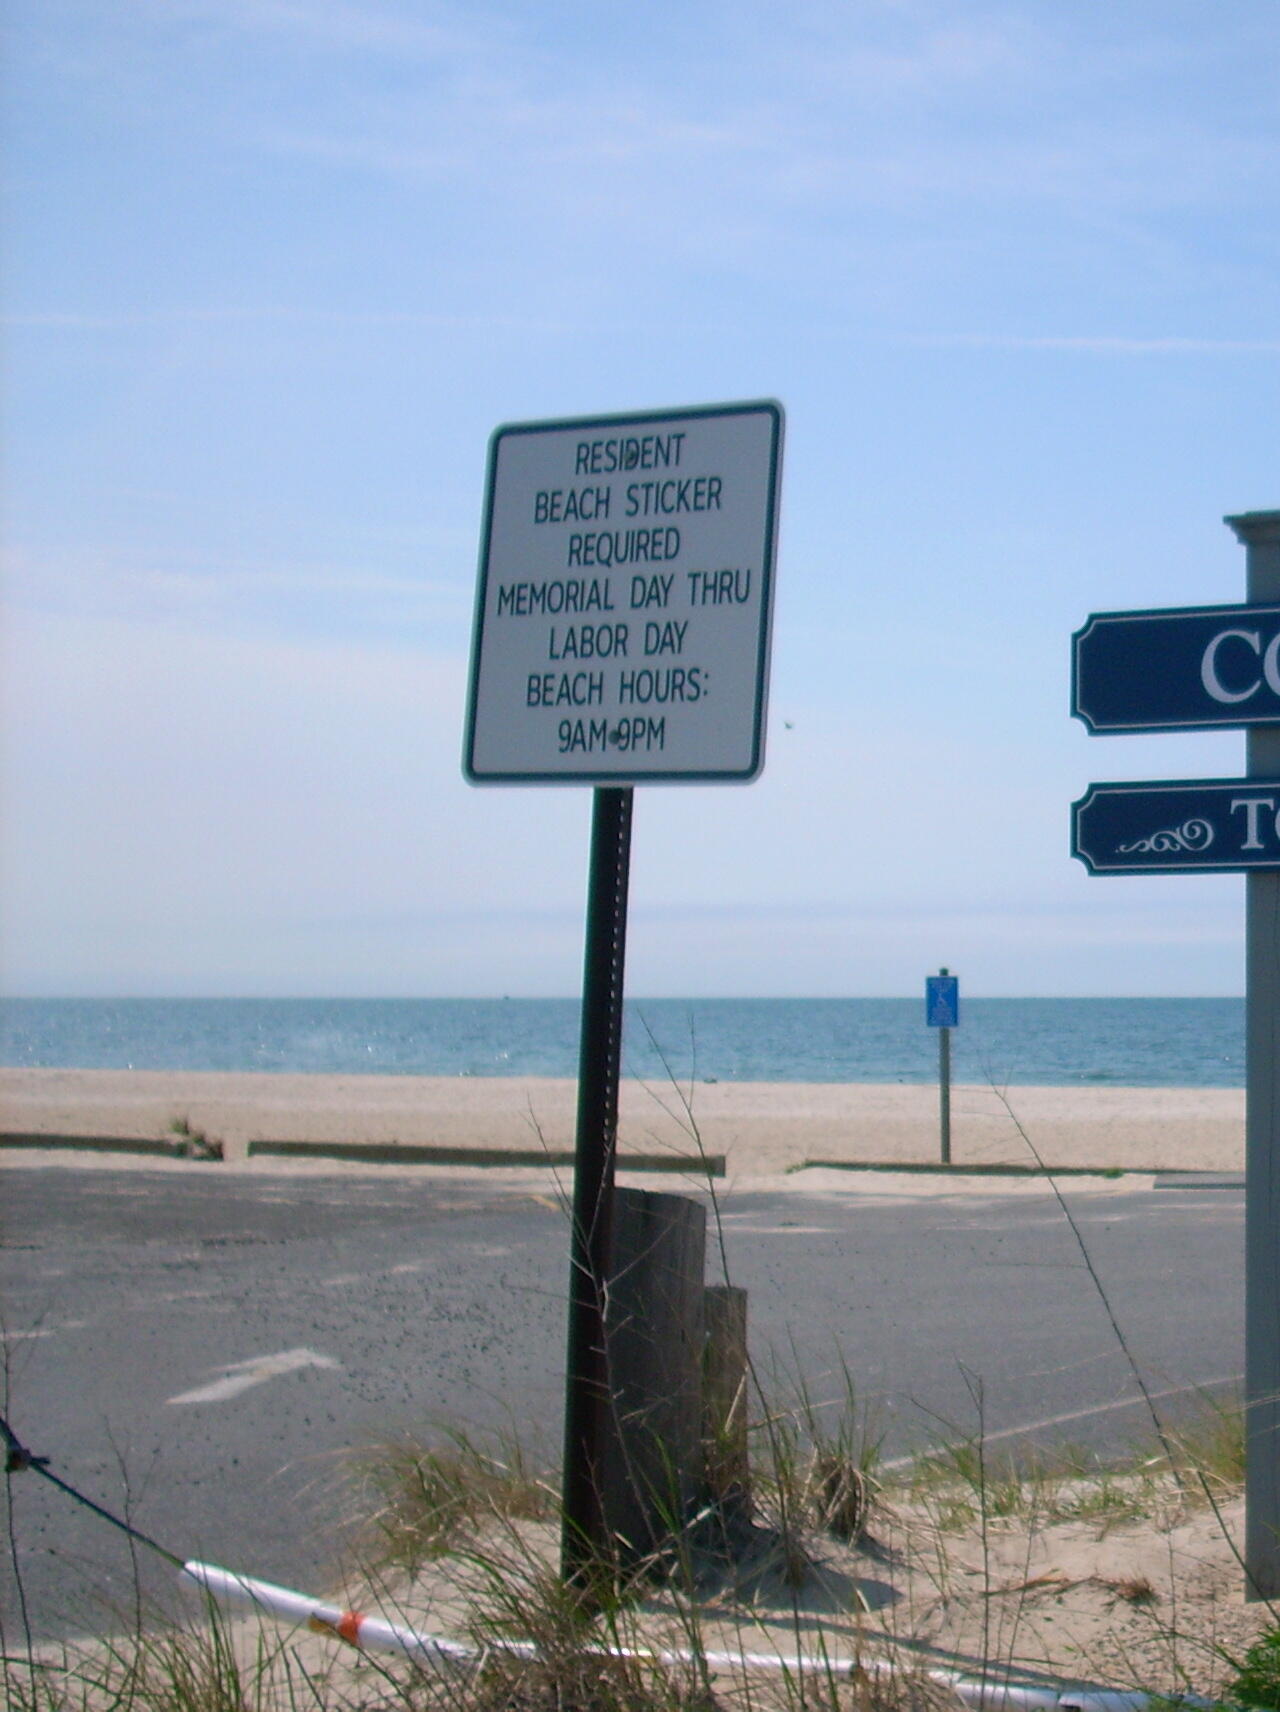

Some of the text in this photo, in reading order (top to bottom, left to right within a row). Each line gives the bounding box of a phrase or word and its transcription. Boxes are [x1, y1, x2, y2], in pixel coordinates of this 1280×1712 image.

[575, 433, 686, 475] RESIDENT
[534, 477, 722, 524] BEACH STICKER
[568, 527, 680, 568] REQUIRED
[497, 569, 751, 616] MEMORIAL DAY THRU
[549, 620, 689, 660] LABOR DAY
[527, 667, 709, 707] BEACH HOURS:
